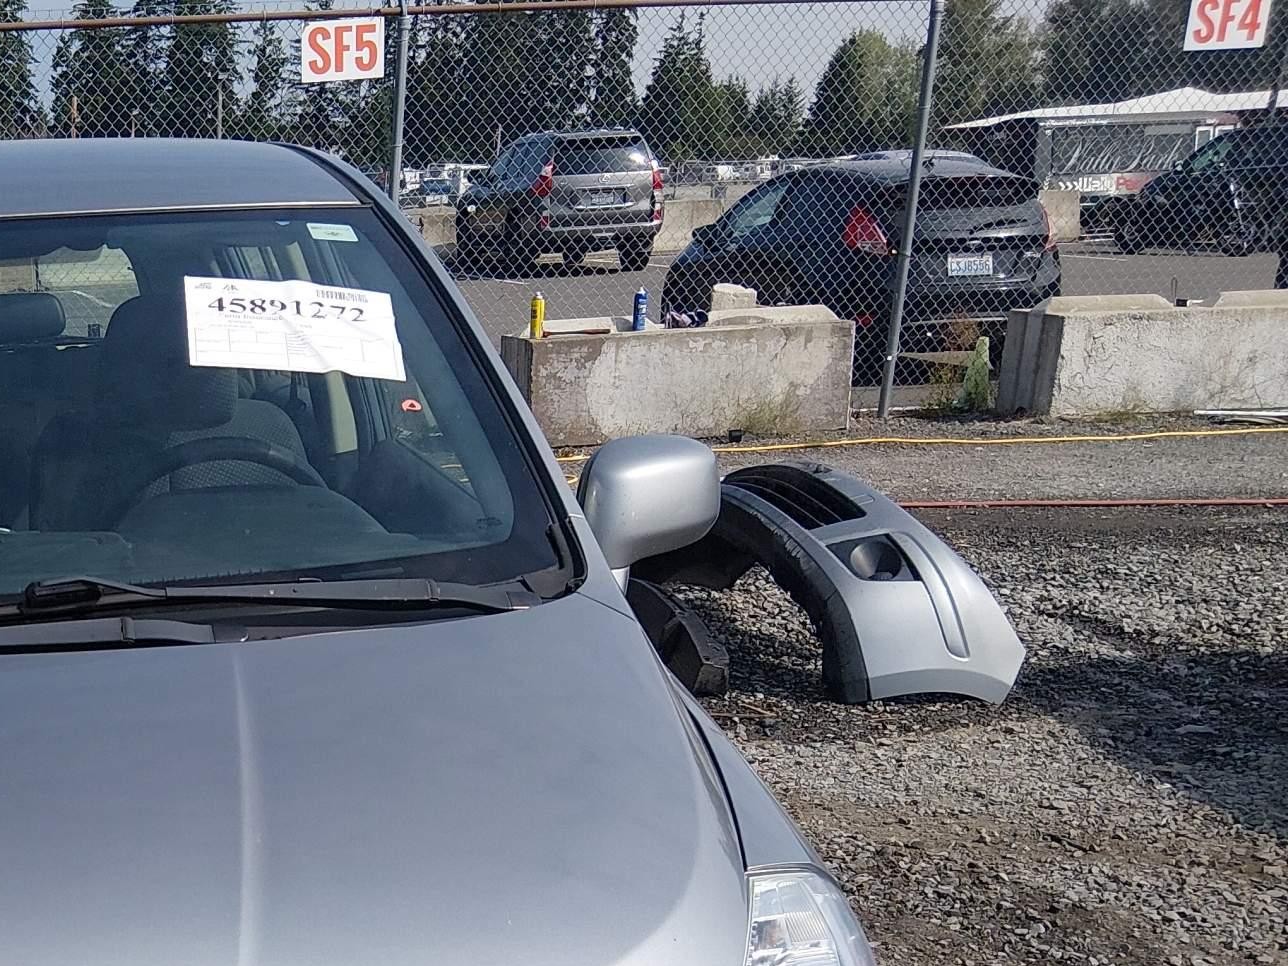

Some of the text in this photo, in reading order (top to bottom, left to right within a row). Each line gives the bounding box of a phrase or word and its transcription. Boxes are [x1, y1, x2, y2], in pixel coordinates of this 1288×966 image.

[1193, 0, 1261, 44] SF4
[307, 23, 378, 75] SF5
[207, 296, 368, 322] 45891272
